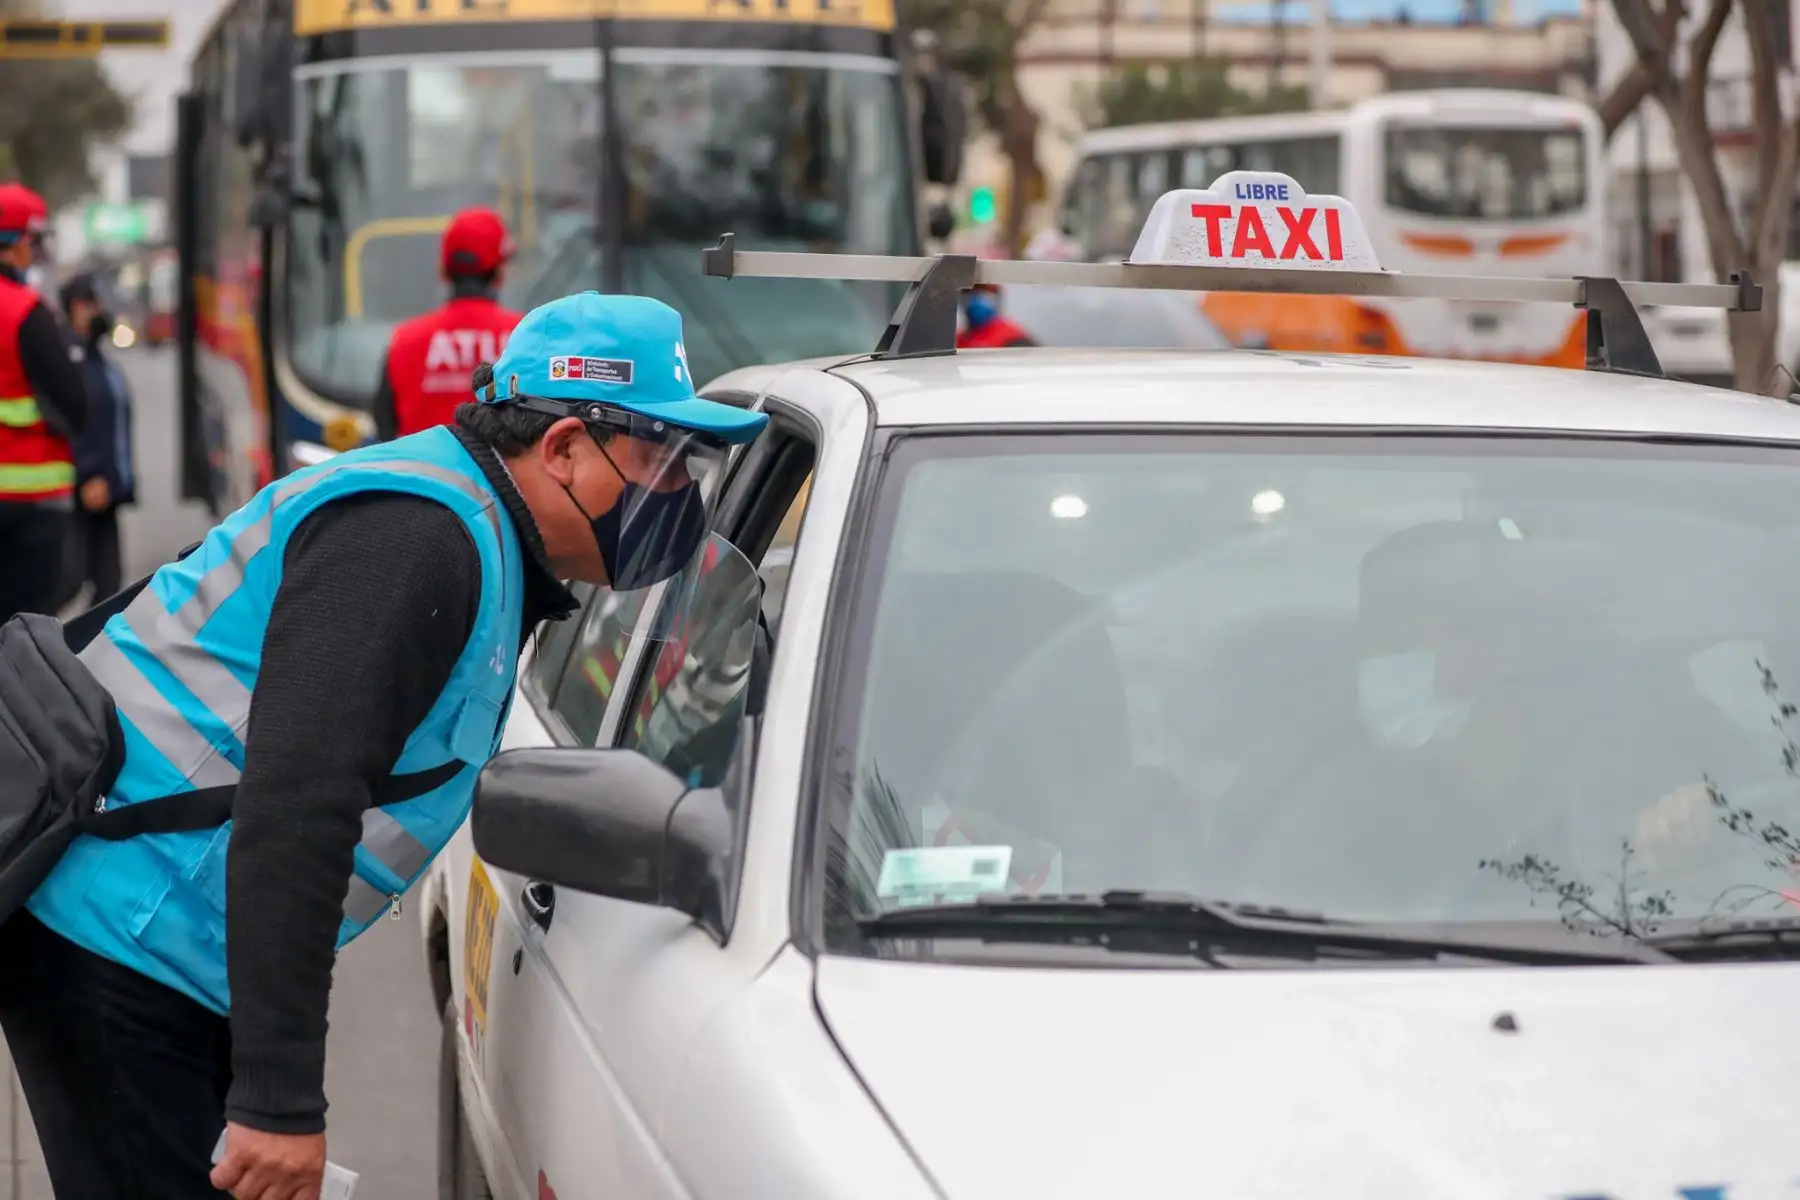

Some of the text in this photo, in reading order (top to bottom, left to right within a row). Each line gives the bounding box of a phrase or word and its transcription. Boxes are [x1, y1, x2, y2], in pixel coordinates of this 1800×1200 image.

[1235, 184, 1289, 201] LIBRE
[1191, 204, 1344, 261] TAXI
[426, 330, 511, 369] ATU
